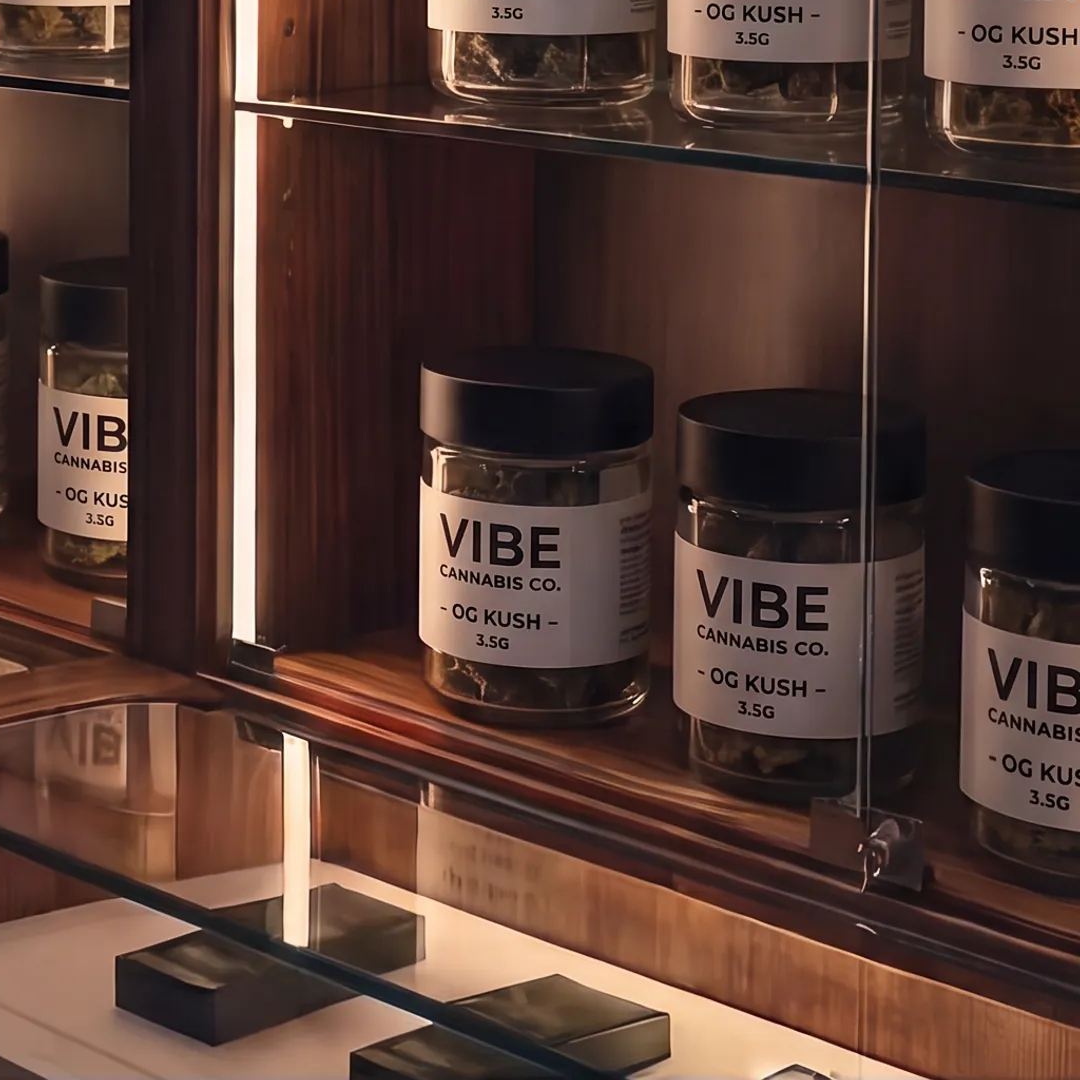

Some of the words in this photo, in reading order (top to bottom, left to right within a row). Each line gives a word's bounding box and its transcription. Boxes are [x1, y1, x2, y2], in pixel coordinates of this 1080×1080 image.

[491, 6, 523, 20] 3.5G
[706, 3, 735, 21] OG
[742, 4, 803, 24] KUSH
[735, 31, 770, 46] 3.5G
[971, 24, 1003, 44] OG
[1011, 26, 1078, 46] KUSH
[1002, 54, 1041, 70] 3.5G
[53, 406, 127, 453] VIB
[54, 451, 127, 474] CANNABIS
[65, 487, 88, 504] OG
[94, 491, 127, 509] KUS
[439, 513, 561, 570] VIBE
[440, 564, 524, 591] CANNABIS
[528, 575, 561, 592] CO.
[696, 569, 829, 632] VIBE
[452, 603, 478, 623] OG
[484, 608, 541, 630] KUSH
[476, 633, 509, 650] 3.5G
[697, 624, 788, 655] CANNABIS
[794, 641, 829, 656] CO.
[710, 667, 739, 689] OG
[745, 673, 807, 698] KUSH
[987, 647, 1080, 716] VIB
[737, 699, 775, 719] 3.5G
[1002, 753, 1033, 778] OG
[1040, 762, 1080, 788] KU
